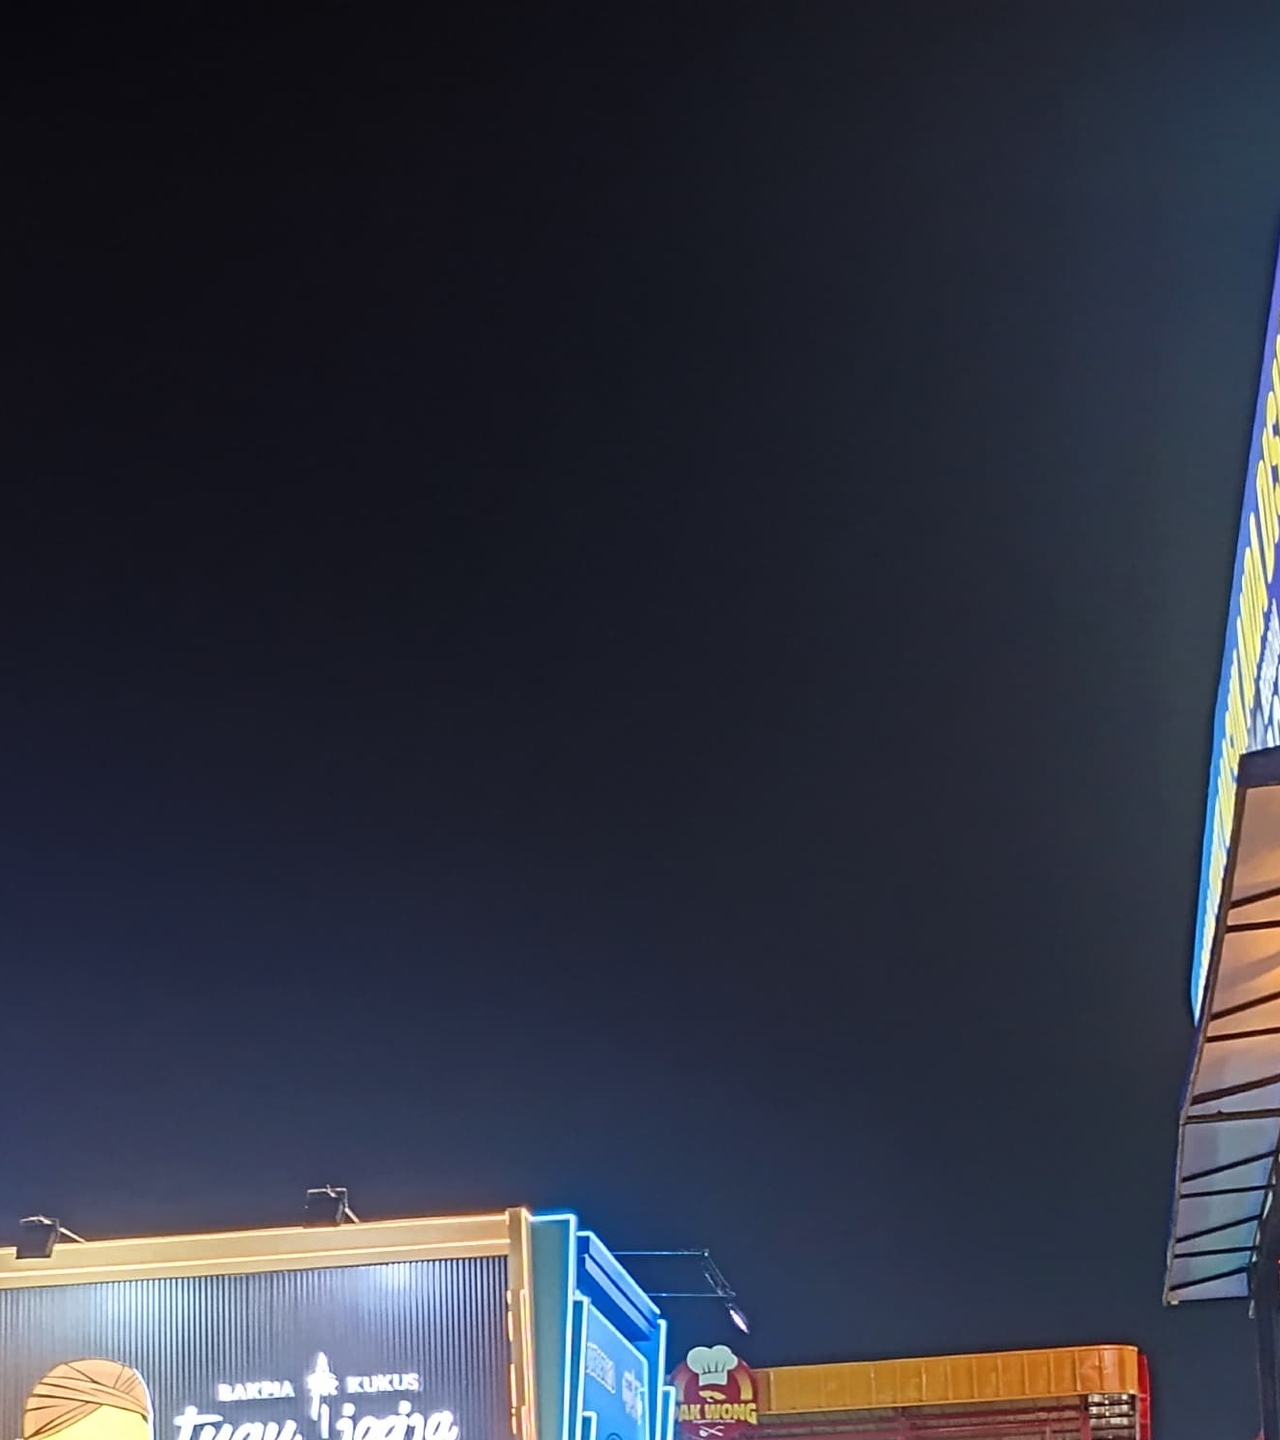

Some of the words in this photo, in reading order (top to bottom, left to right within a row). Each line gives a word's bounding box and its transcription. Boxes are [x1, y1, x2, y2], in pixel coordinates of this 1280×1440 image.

[218, 1380, 295, 1402] BAKPIA
[346, 1372, 421, 1394] KUKUS
[704, 1403, 757, 1425] WONG
